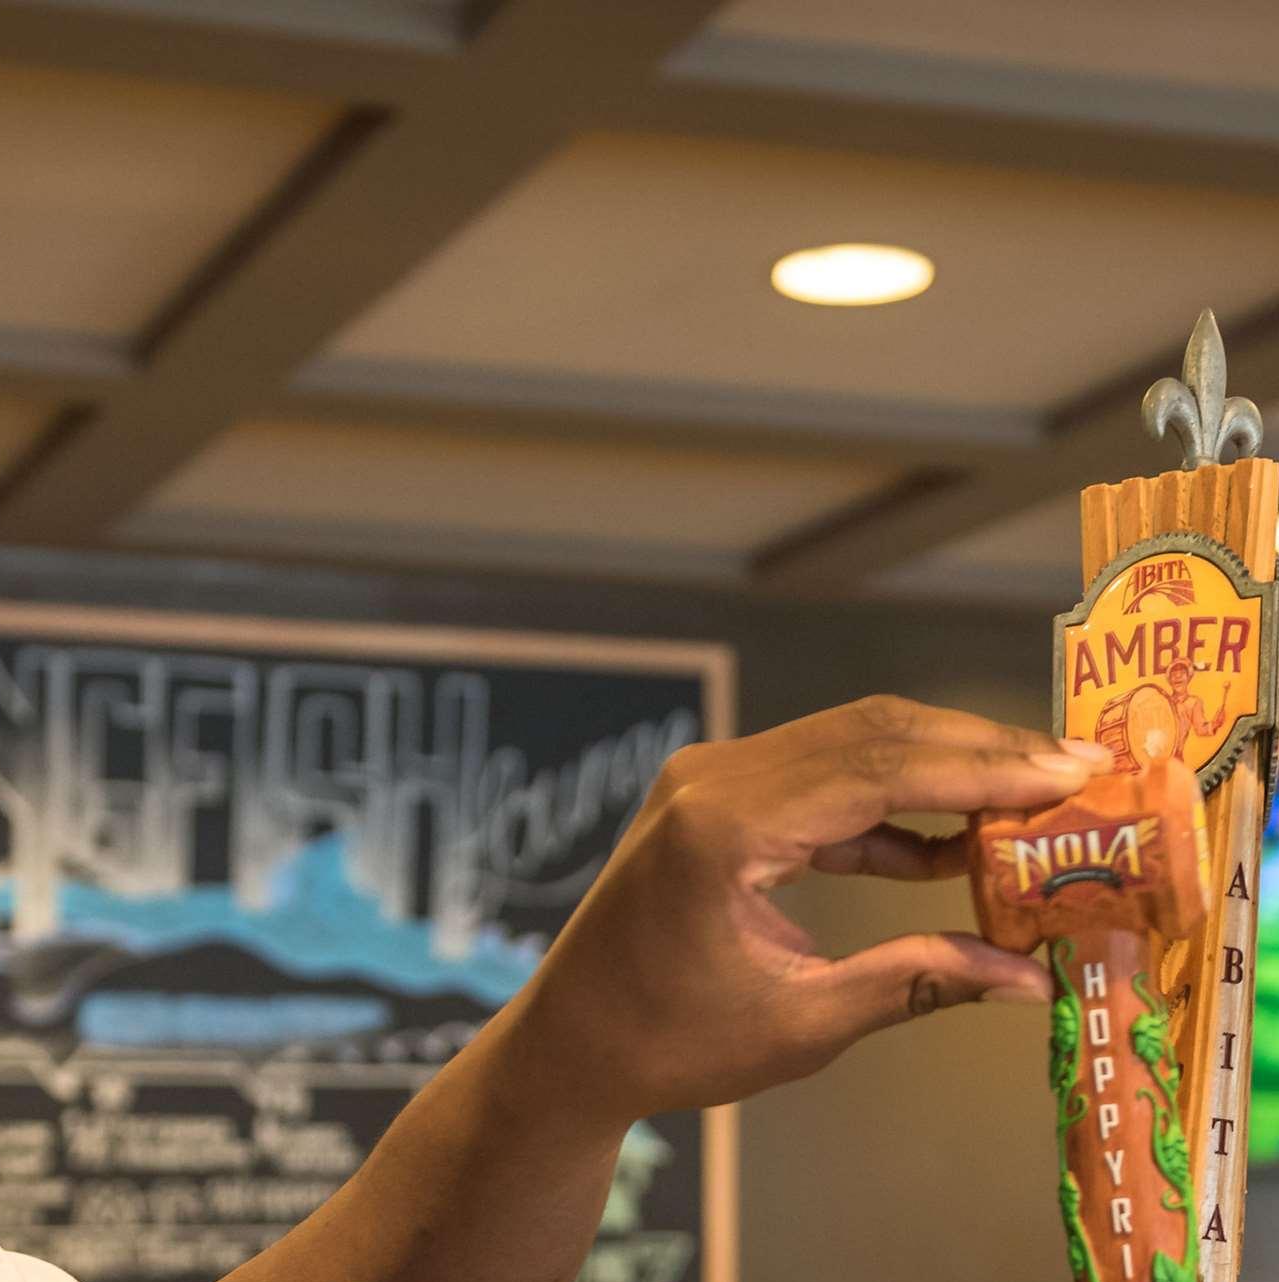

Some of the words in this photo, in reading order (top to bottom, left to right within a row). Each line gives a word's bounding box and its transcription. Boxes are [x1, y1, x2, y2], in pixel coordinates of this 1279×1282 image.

[1122, 559, 1192, 611] ABITA
[1073, 616, 1252, 697] AMBER
[1013, 824, 1143, 893] NOLA
[1202, 861, 1250, 1243] ABITA
